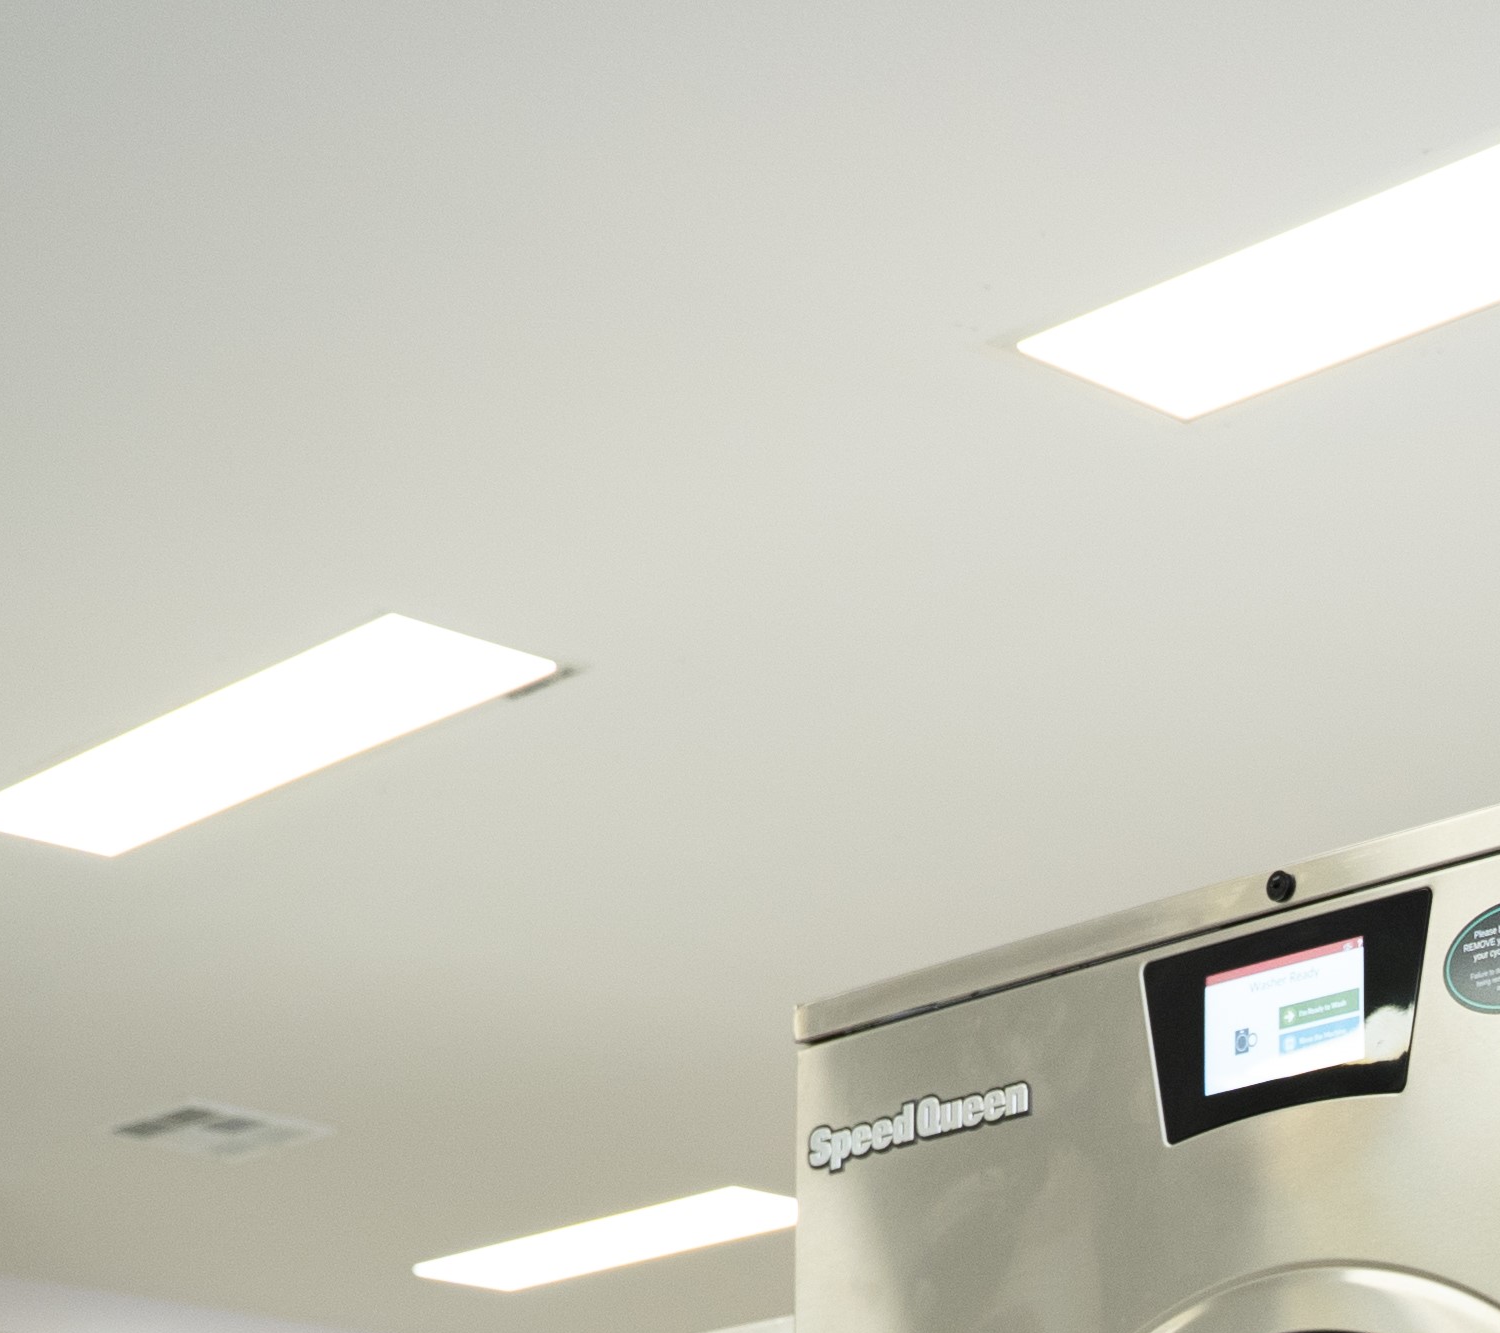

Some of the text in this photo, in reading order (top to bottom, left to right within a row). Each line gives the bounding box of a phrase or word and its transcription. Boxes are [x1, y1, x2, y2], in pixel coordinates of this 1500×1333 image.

[1474, 928, 1497, 939] Please
[1463, 938, 1496, 952] REMOVE
[1473, 951, 1488, 963] your
[808, 1081, 1029, 1171] Speed Queen
